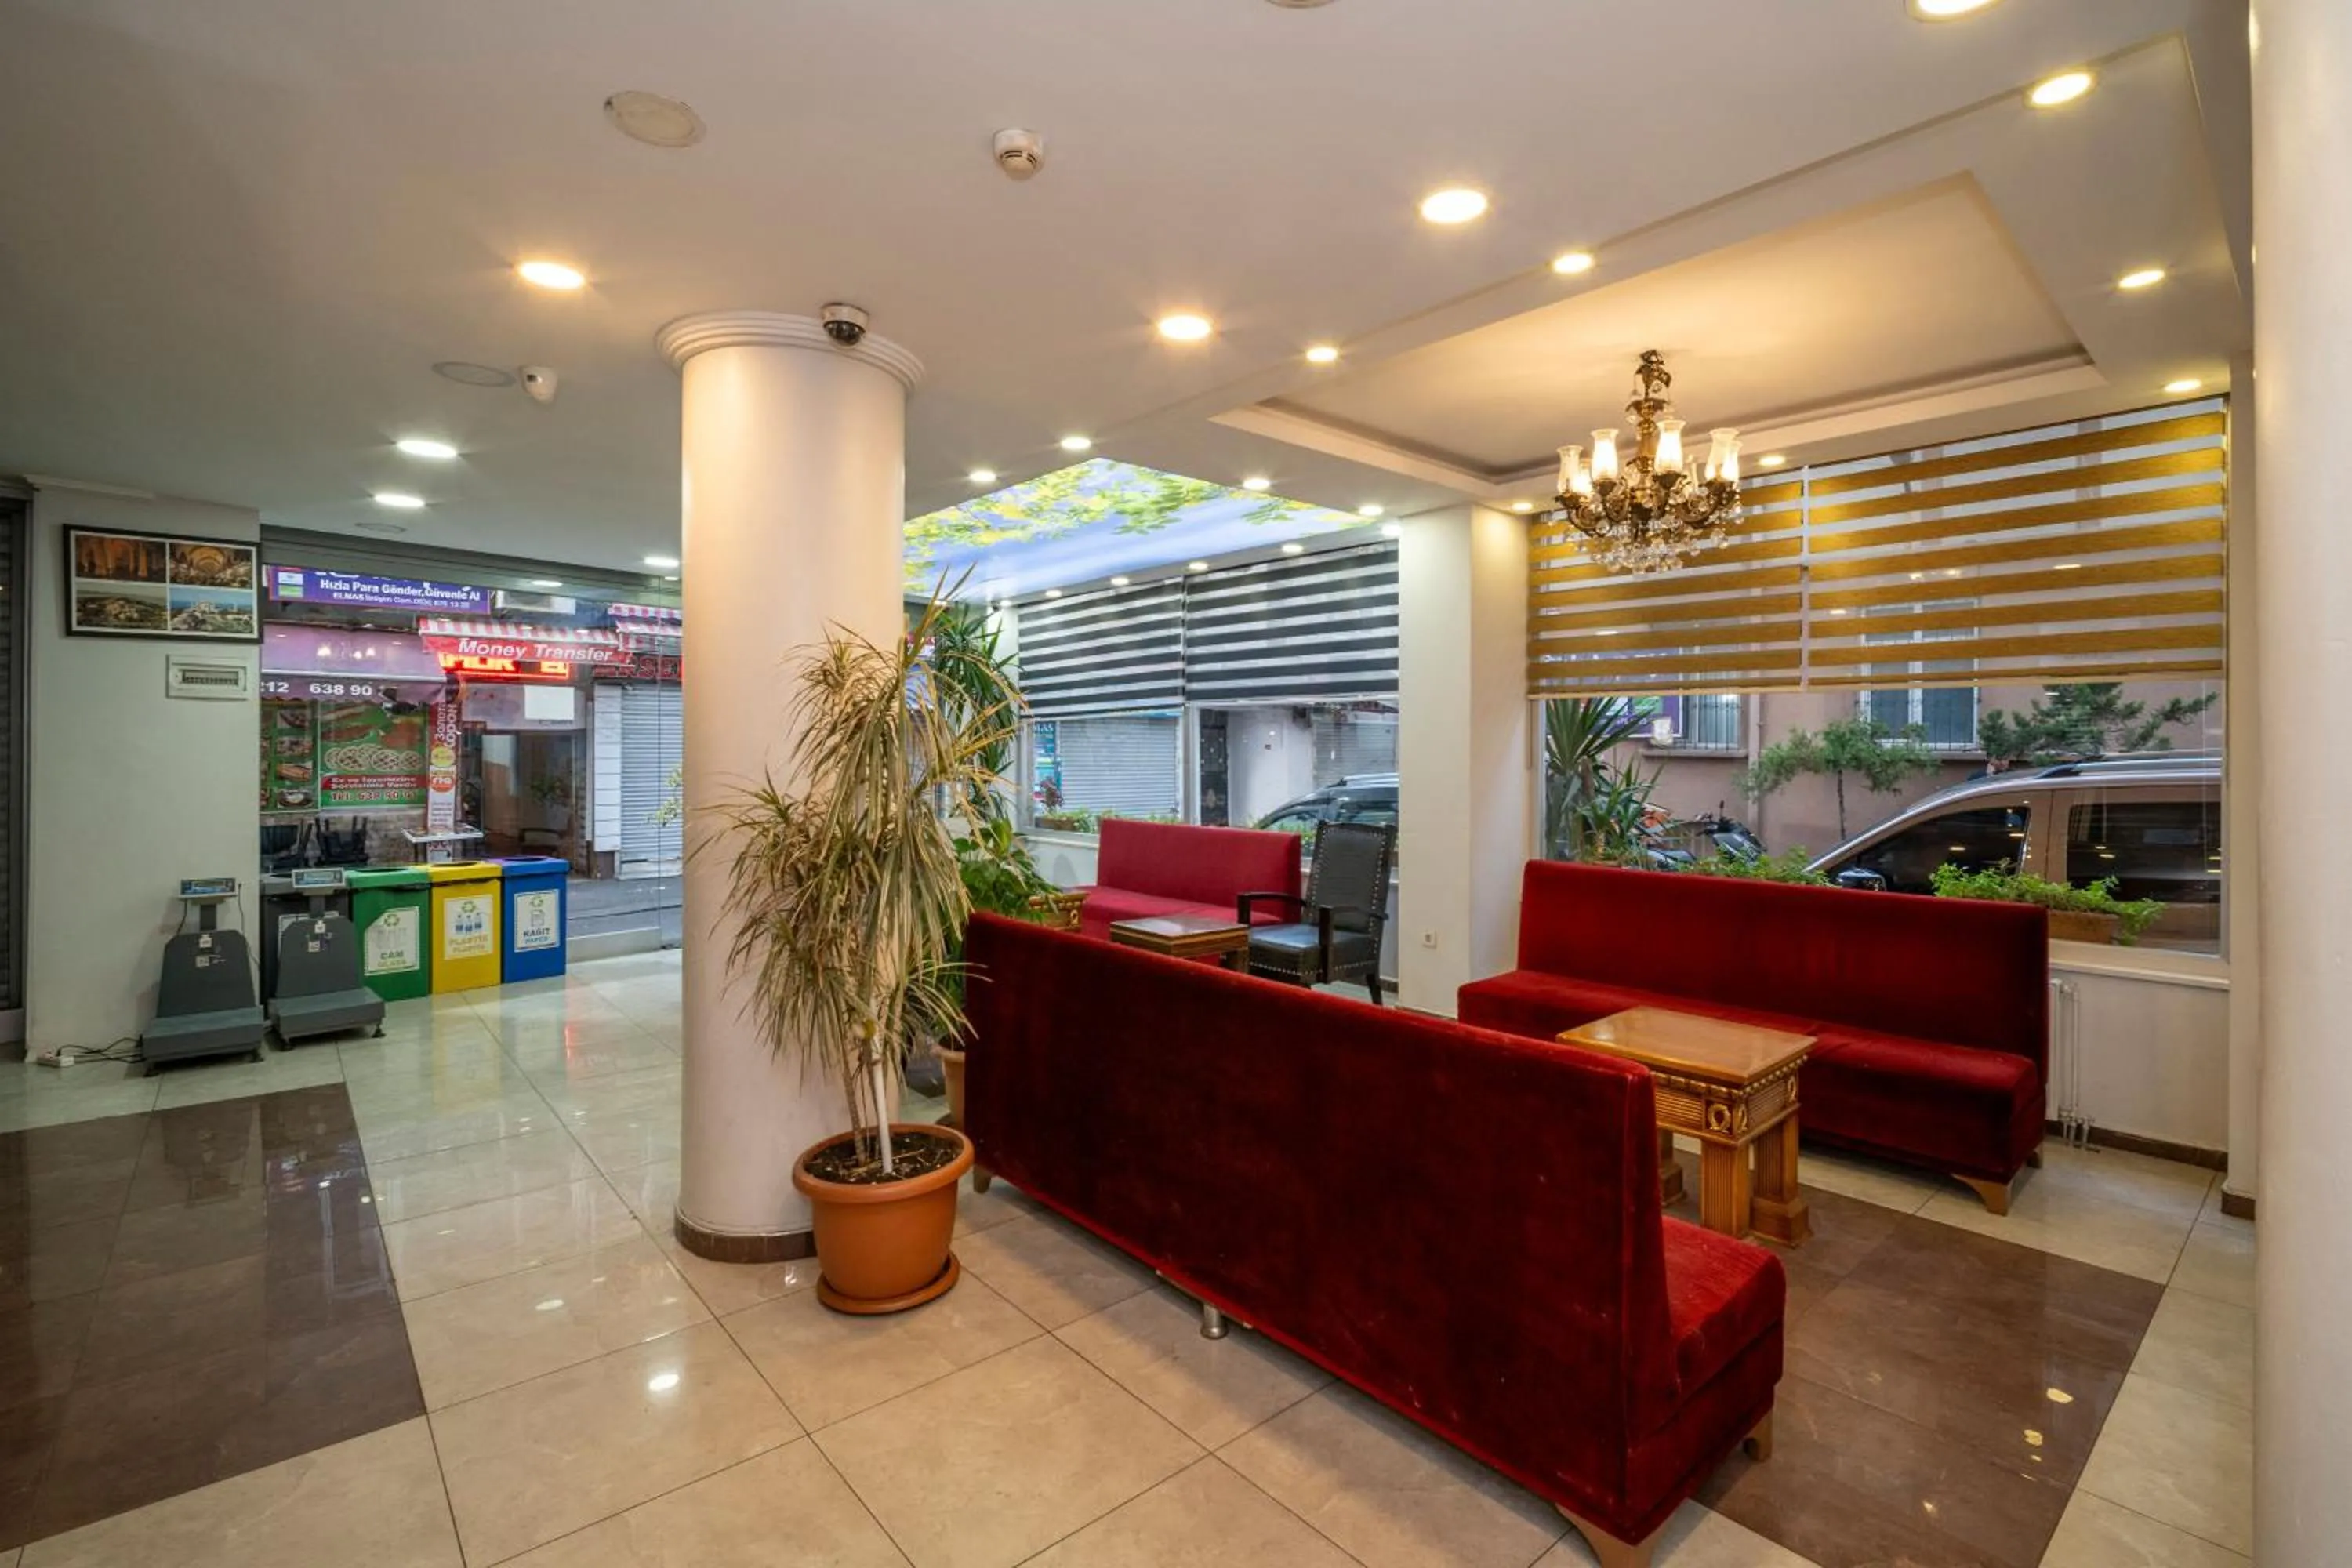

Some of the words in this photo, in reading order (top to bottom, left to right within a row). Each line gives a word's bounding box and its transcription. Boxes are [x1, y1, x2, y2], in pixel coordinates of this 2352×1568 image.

[352, 581, 379, 593] Para
[458, 637, 526, 659] Money
[534, 644, 612, 662] Transfer
[260, 681, 289, 693] 12
[309, 683, 344, 695] 638
[350, 684, 372, 695] 90
[380, 950, 404, 960] CAM
